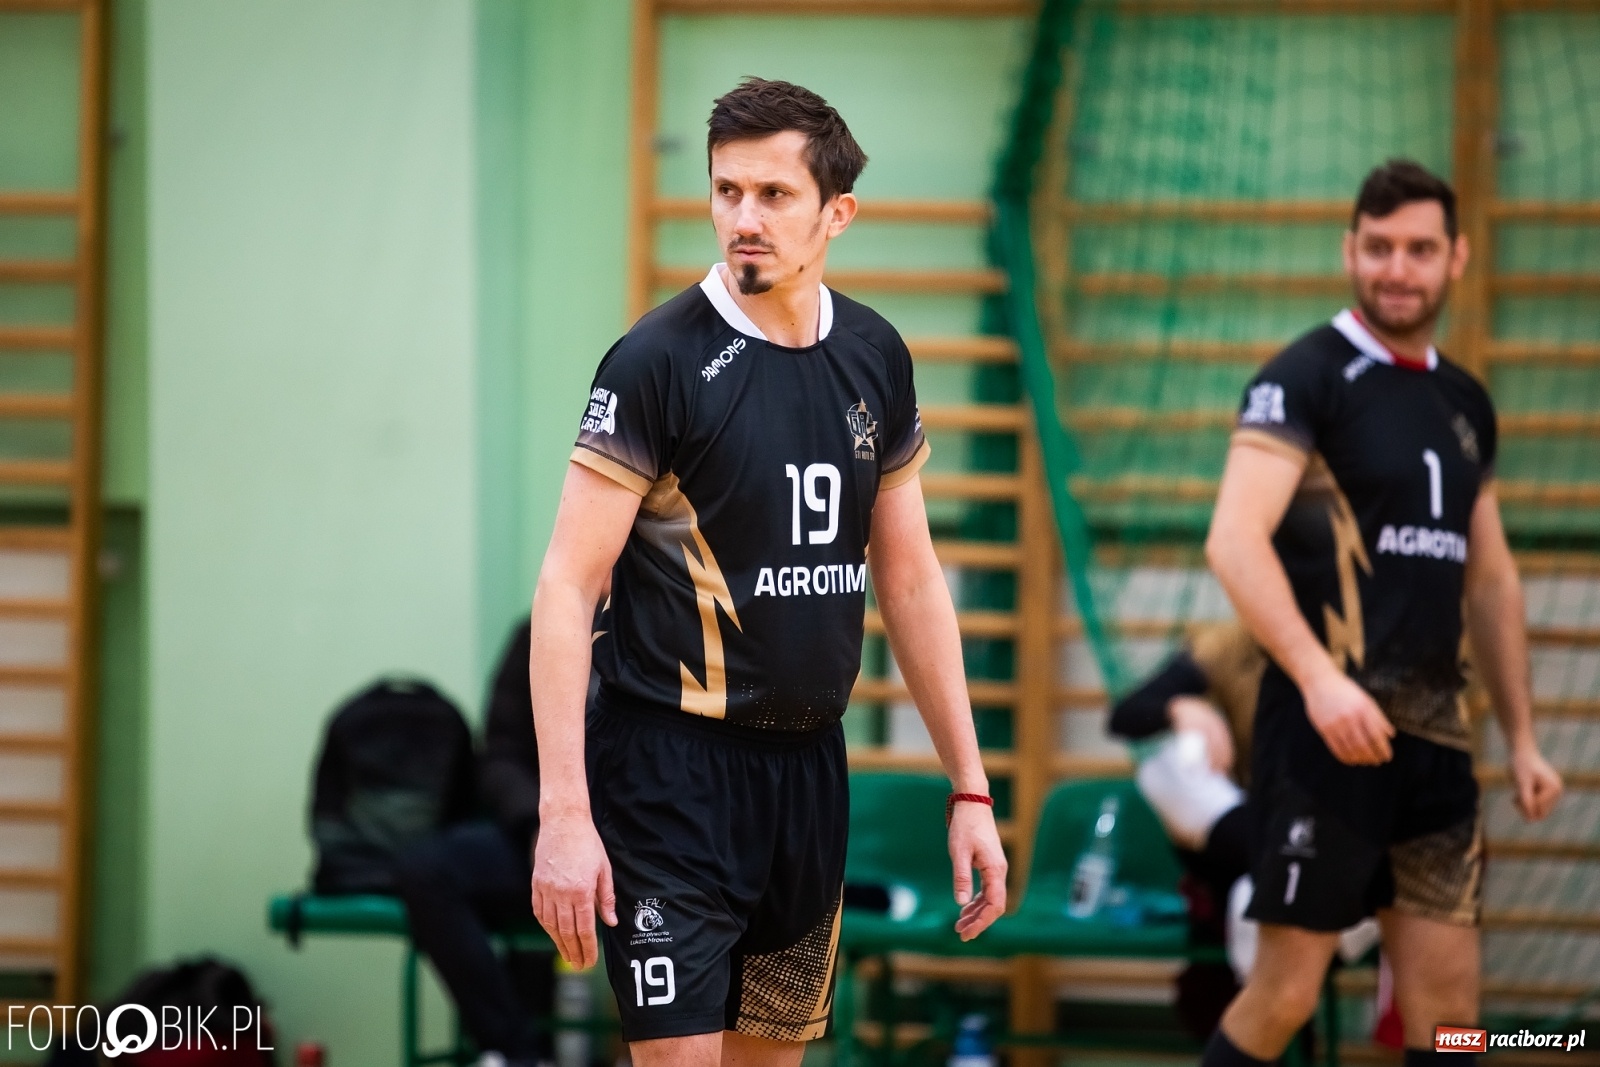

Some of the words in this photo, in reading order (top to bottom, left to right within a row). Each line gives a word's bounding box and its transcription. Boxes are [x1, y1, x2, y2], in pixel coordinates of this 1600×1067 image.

[785, 463, 841, 546] 19
[1423, 449, 1443, 519] 1
[754, 563, 867, 597] AGROTIM
[1283, 862, 1300, 905] 1
[630, 956, 676, 1006] 19
